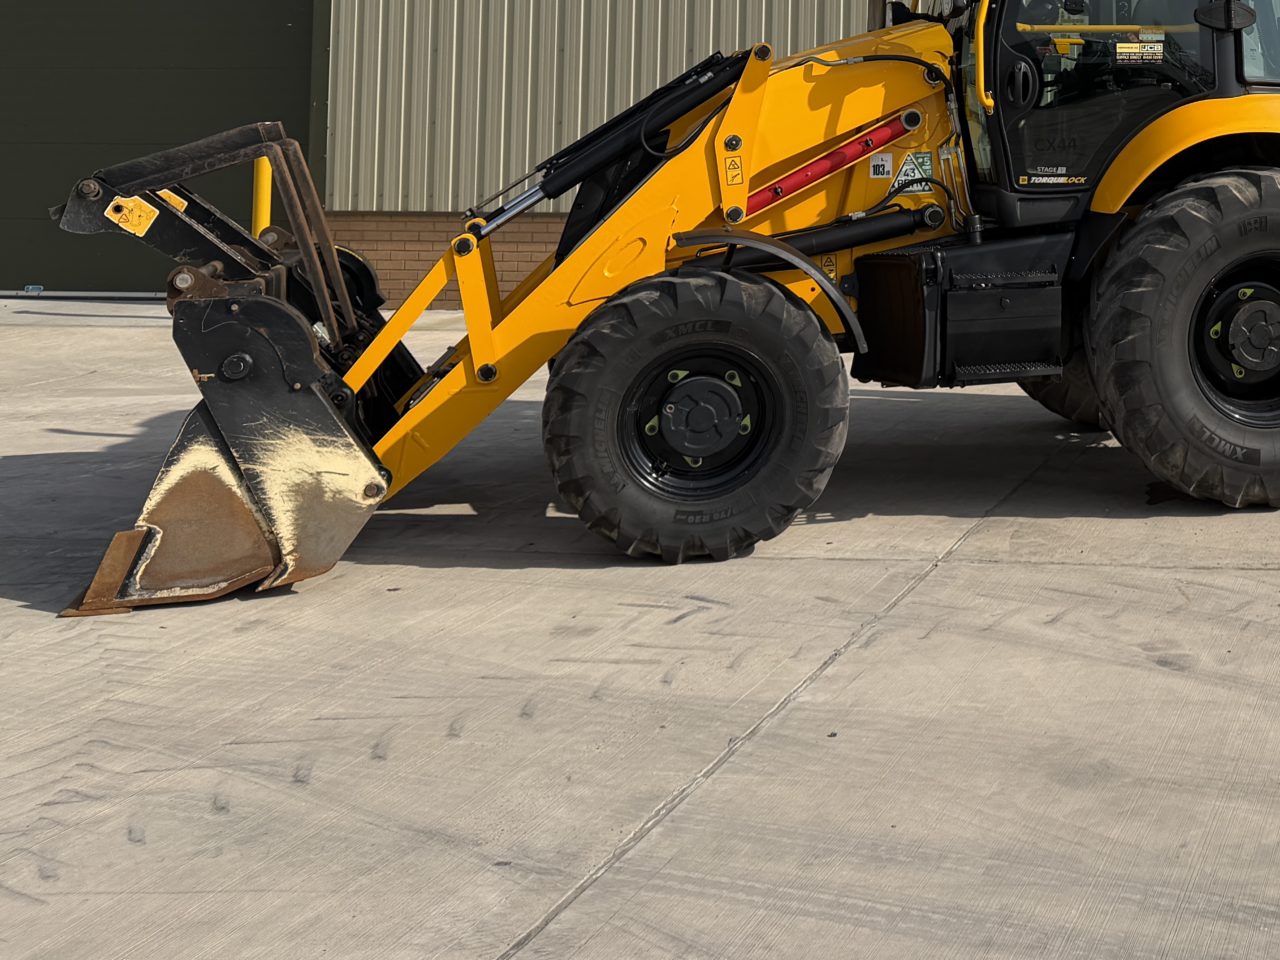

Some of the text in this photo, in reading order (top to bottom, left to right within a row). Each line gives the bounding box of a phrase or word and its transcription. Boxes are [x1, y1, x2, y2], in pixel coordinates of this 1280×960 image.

[872, 163, 886, 176] 103
[903, 167, 916, 178] 43
[1194, 425, 1248, 462] XMCL
